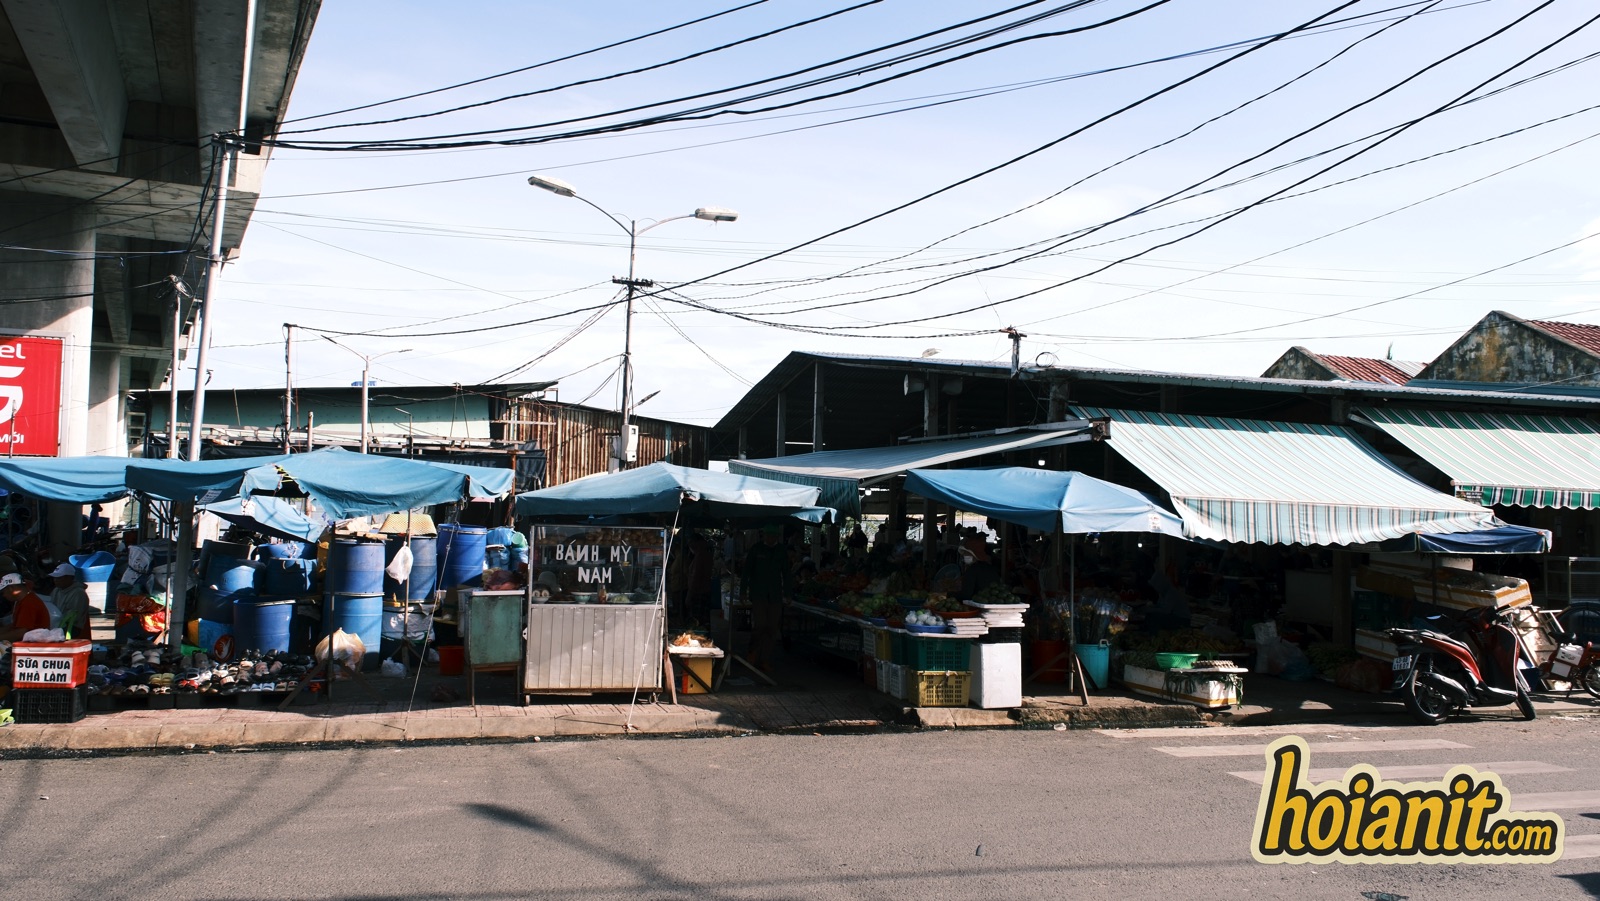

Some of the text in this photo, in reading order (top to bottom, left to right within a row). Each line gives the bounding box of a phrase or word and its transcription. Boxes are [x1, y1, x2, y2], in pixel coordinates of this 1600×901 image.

[578, 567, 612, 584] NAM
[17, 658, 70, 669] SỮA CHUA
[19, 671, 67, 682] NHÀ LÀM
